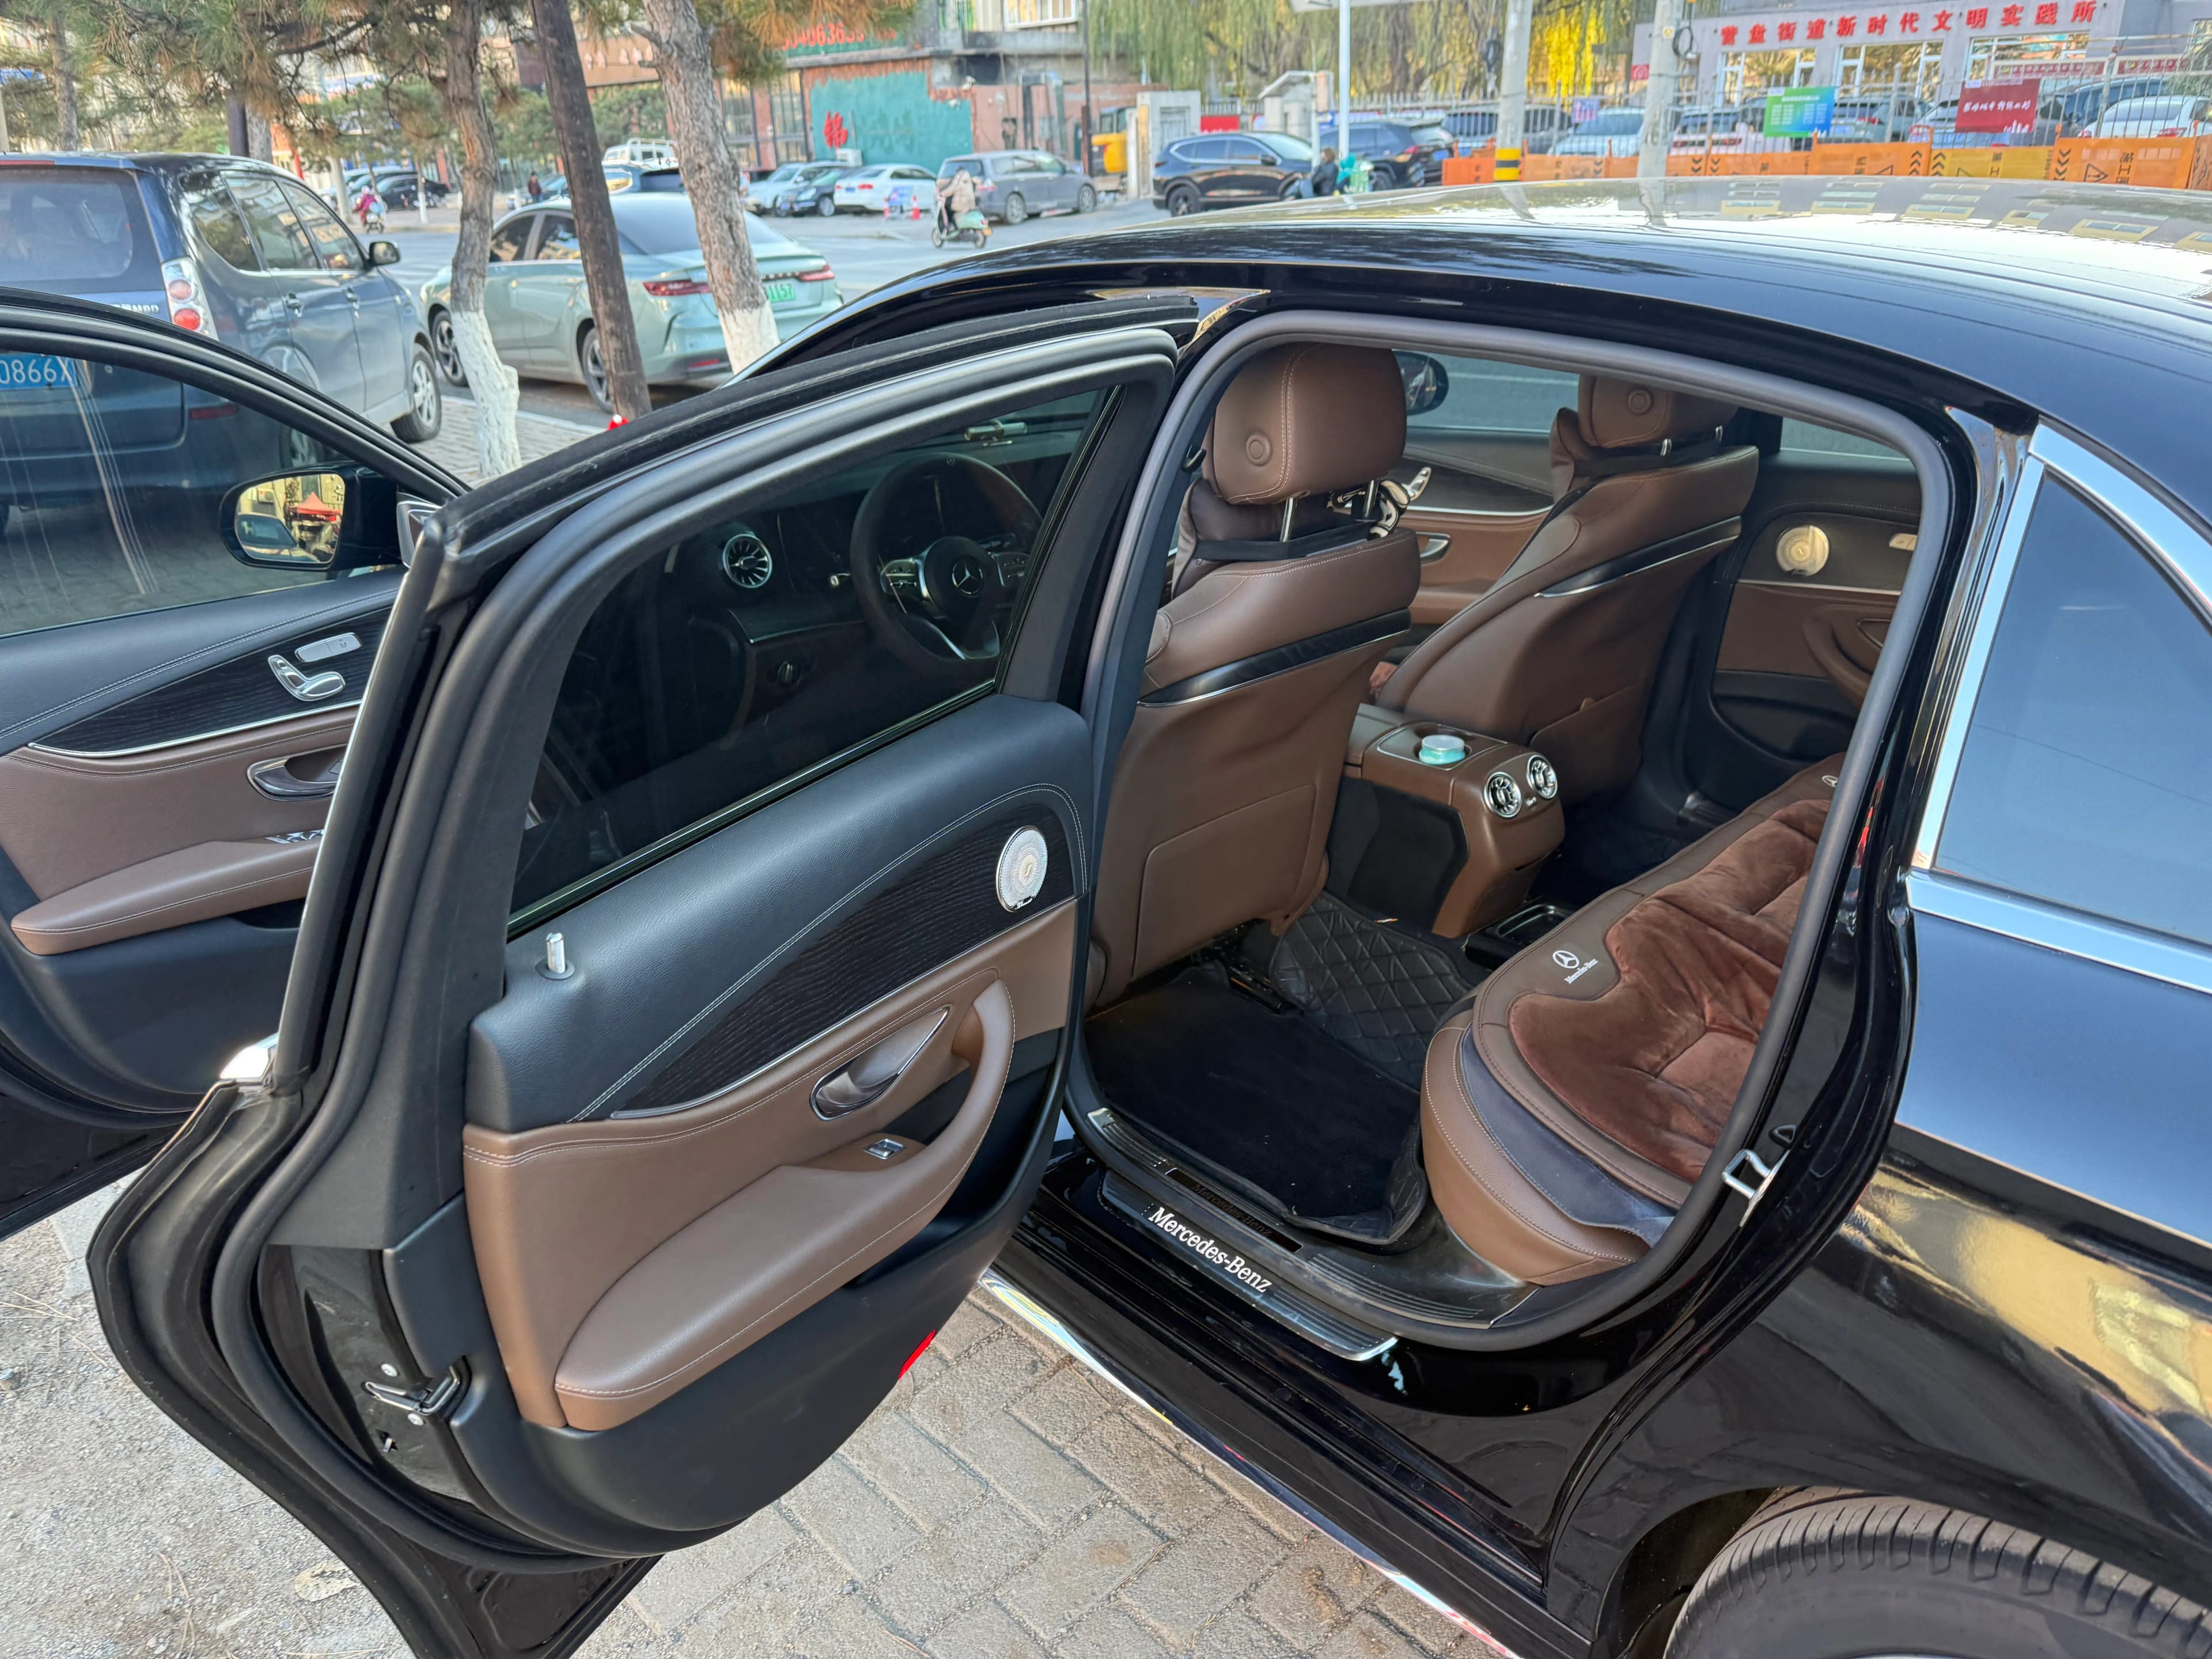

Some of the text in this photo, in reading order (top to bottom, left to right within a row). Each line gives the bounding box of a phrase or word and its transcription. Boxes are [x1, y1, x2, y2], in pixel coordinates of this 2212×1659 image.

[1721, 0, 2096, 46] 营盘街道新时代文明实践所
[1191, 1184, 1272, 1236] Mercedes-Benz
[1148, 1207, 1272, 1293] Mercedes-Benz
